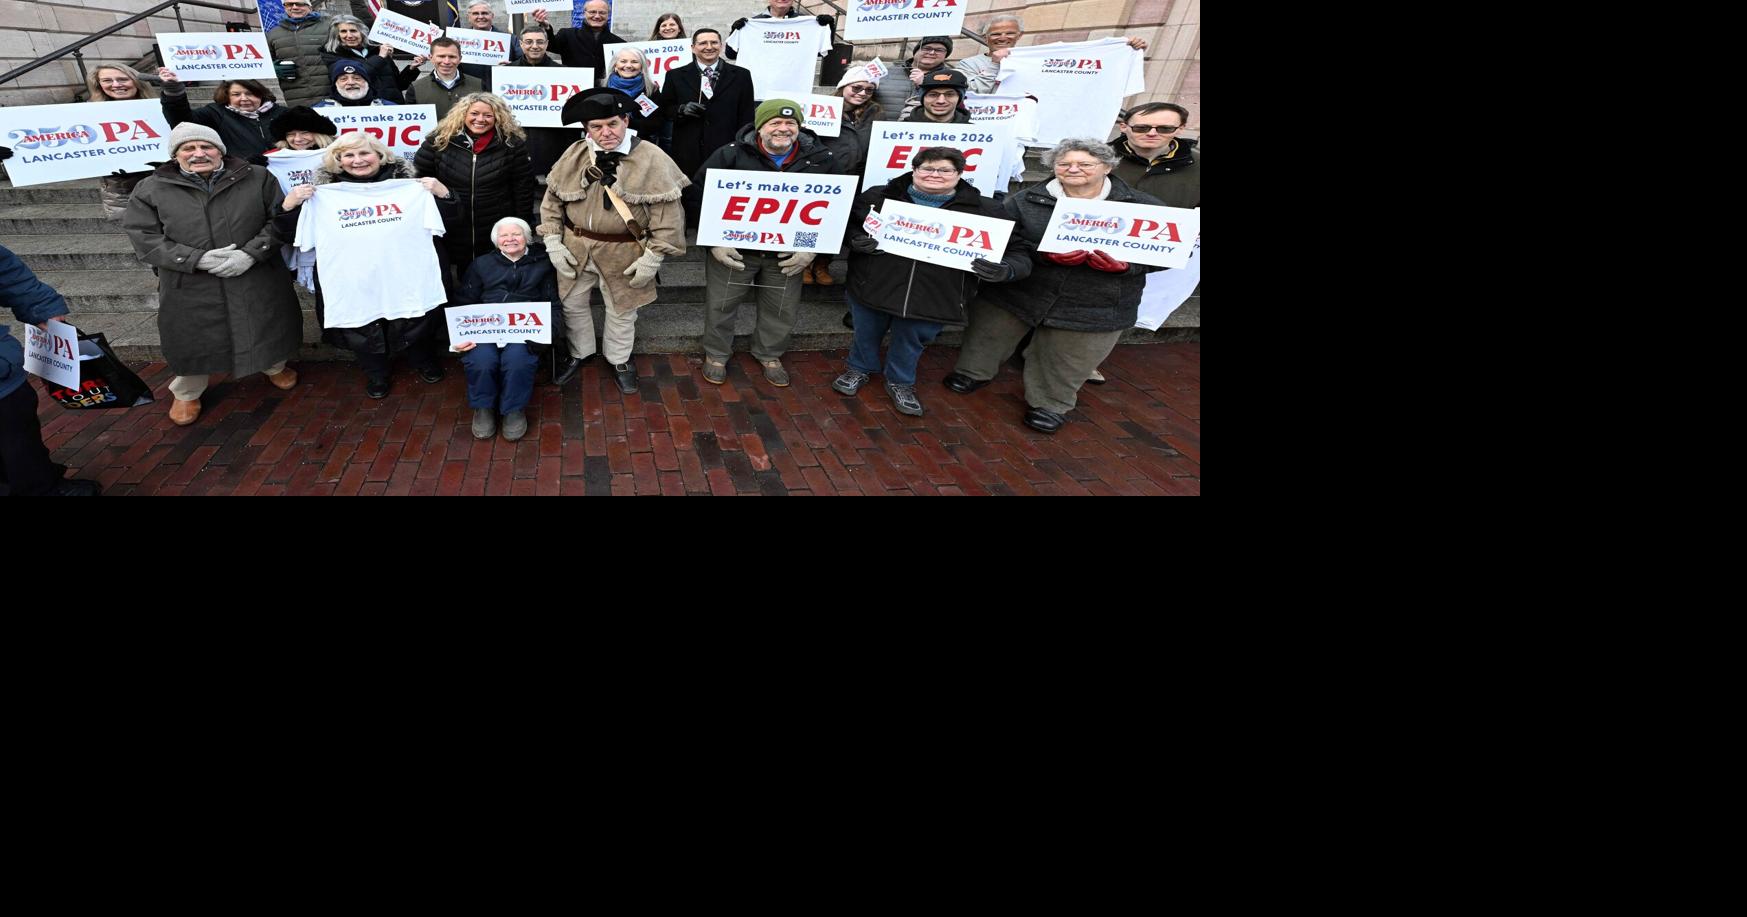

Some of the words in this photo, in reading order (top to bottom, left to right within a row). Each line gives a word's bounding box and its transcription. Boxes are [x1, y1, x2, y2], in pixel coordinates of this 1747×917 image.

[857, 14, 909, 22] LANCASTER
[911, 11, 953, 19] COUNTY
[377, 30, 408, 44] LANCASTER
[408, 41, 430, 51] COUNTY
[483, 39, 505, 52] PA
[168, 44, 222, 61] 250
[223, 44, 264, 60] PA
[176, 48, 217, 56] AMERICA
[175, 63, 227, 71] LANCASTER
[1077, 59, 1102, 69] PA
[500, 84, 548, 101] 250
[809, 104, 837, 119] PA
[997, 104, 1018, 114] PA
[361, 114, 393, 122] make
[398, 113, 426, 121] 2026
[8, 124, 98, 150] 250
[99, 119, 161, 143] PA
[22, 130, 90, 143] AMERICA
[883, 131, 914, 140] Let's
[920, 133, 956, 141] make
[961, 133, 994, 142] 2026
[22, 148, 106, 164] LANCASTER
[110, 143, 161, 155] COUNTY
[886, 145, 983, 171] EC
[717, 179, 752, 190] Let's
[758, 183, 799, 193] make
[804, 184, 842, 195] 2026
[338, 206, 374, 221] 250
[375, 203, 402, 216] PA
[722, 196, 829, 225] EPIC
[341, 220, 376, 228] LANCASTER
[895, 220, 939, 234] AMERICA
[1058, 212, 1126, 234] 250
[1127, 219, 1182, 242] PA
[1069, 218, 1119, 229] AMERICA
[722, 230, 758, 243] 250
[759, 232, 785, 244] PA
[885, 214, 946, 239] 250
[947, 225, 994, 250] PA
[883, 234, 941, 251] LANCASTER
[942, 246, 987, 260] COUNTY
[1056, 234, 1120, 247] LANCASTER
[1122, 241, 1175, 253] COUNTY
[455, 314, 505, 328] 250
[507, 312, 544, 326] PA
[53, 335, 74, 360] PA
[29, 351, 53, 364] LANCASTER
[53, 360, 72, 372] COUNTY
